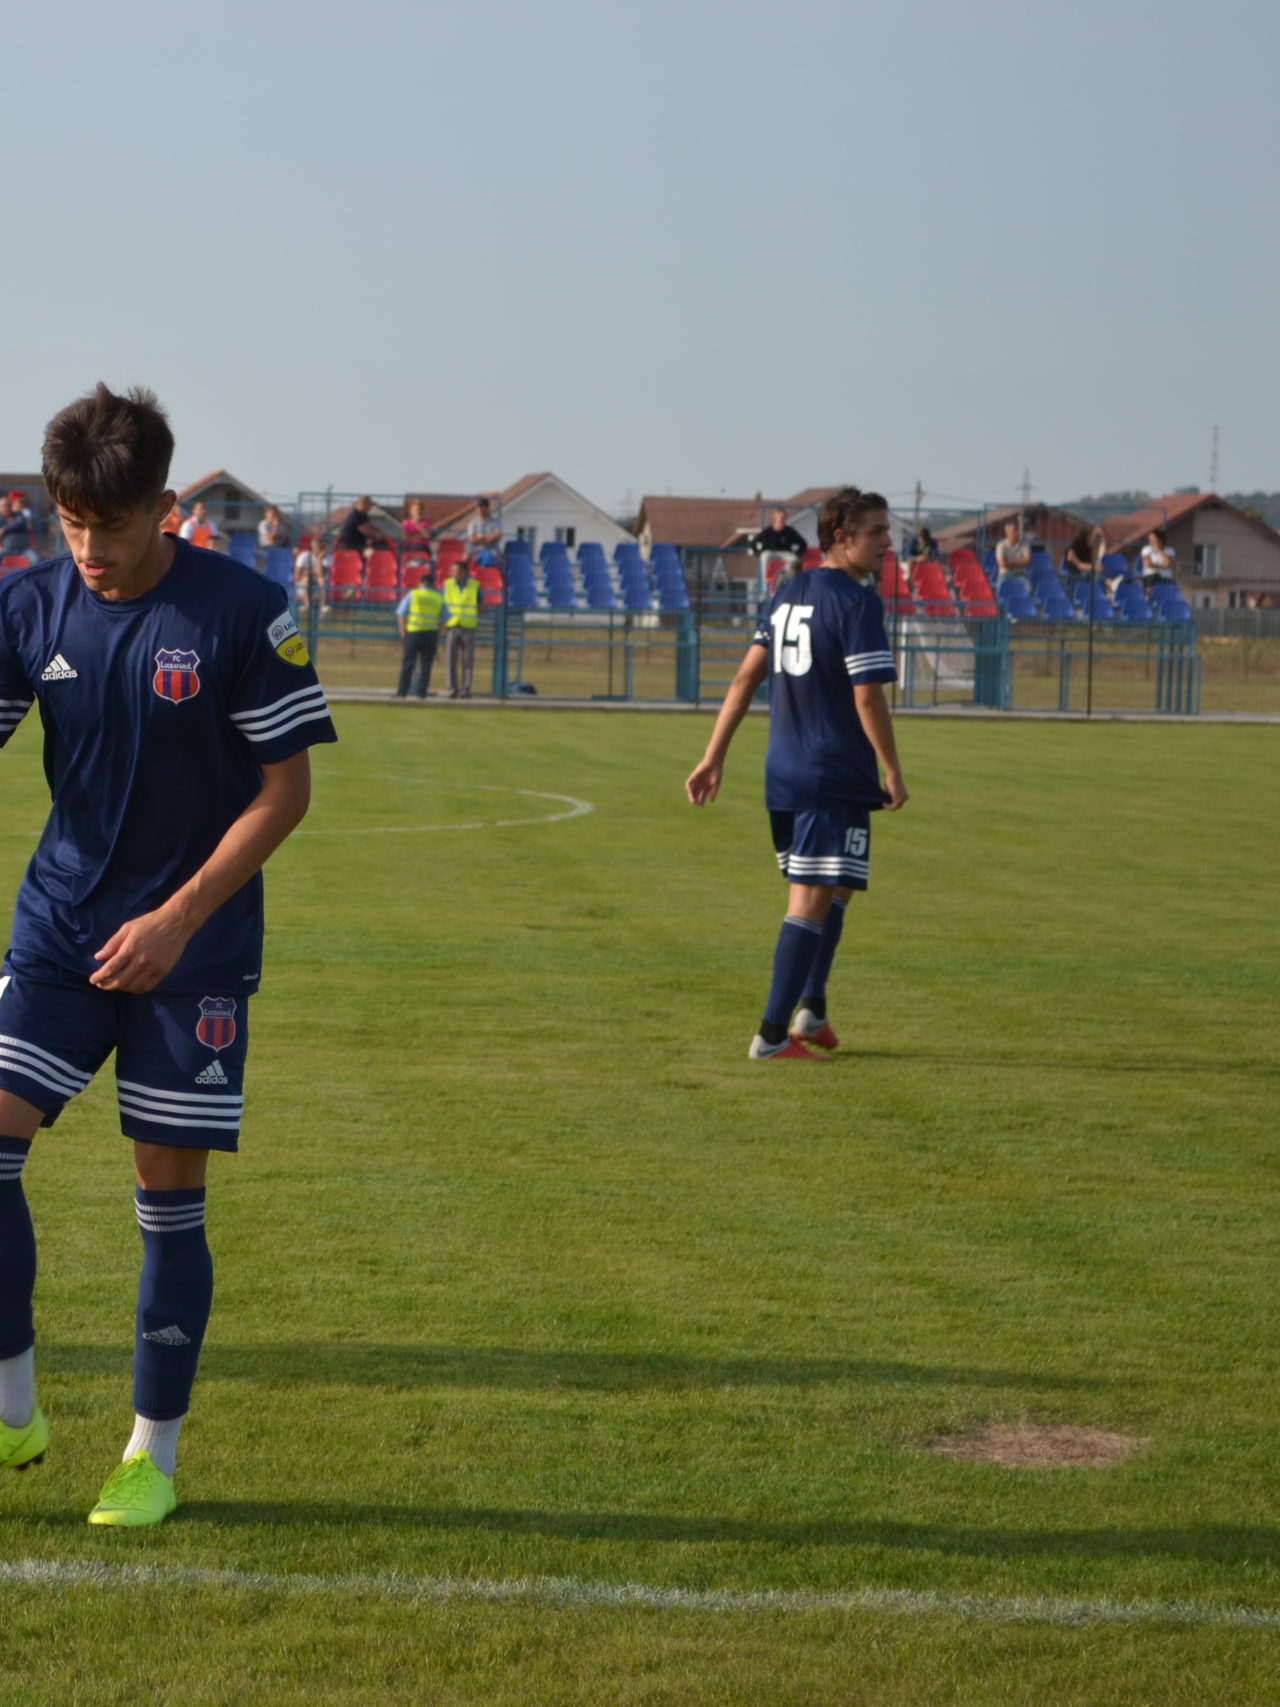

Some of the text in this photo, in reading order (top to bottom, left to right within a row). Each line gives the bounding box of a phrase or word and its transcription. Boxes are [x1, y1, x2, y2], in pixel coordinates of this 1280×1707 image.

[770, 603, 814, 676] 15
[41, 669, 78, 681] adidas
[844, 826, 868, 857] 15
[195, 1075, 229, 1085] adidas
[142, 1332, 191, 1346] adidas
